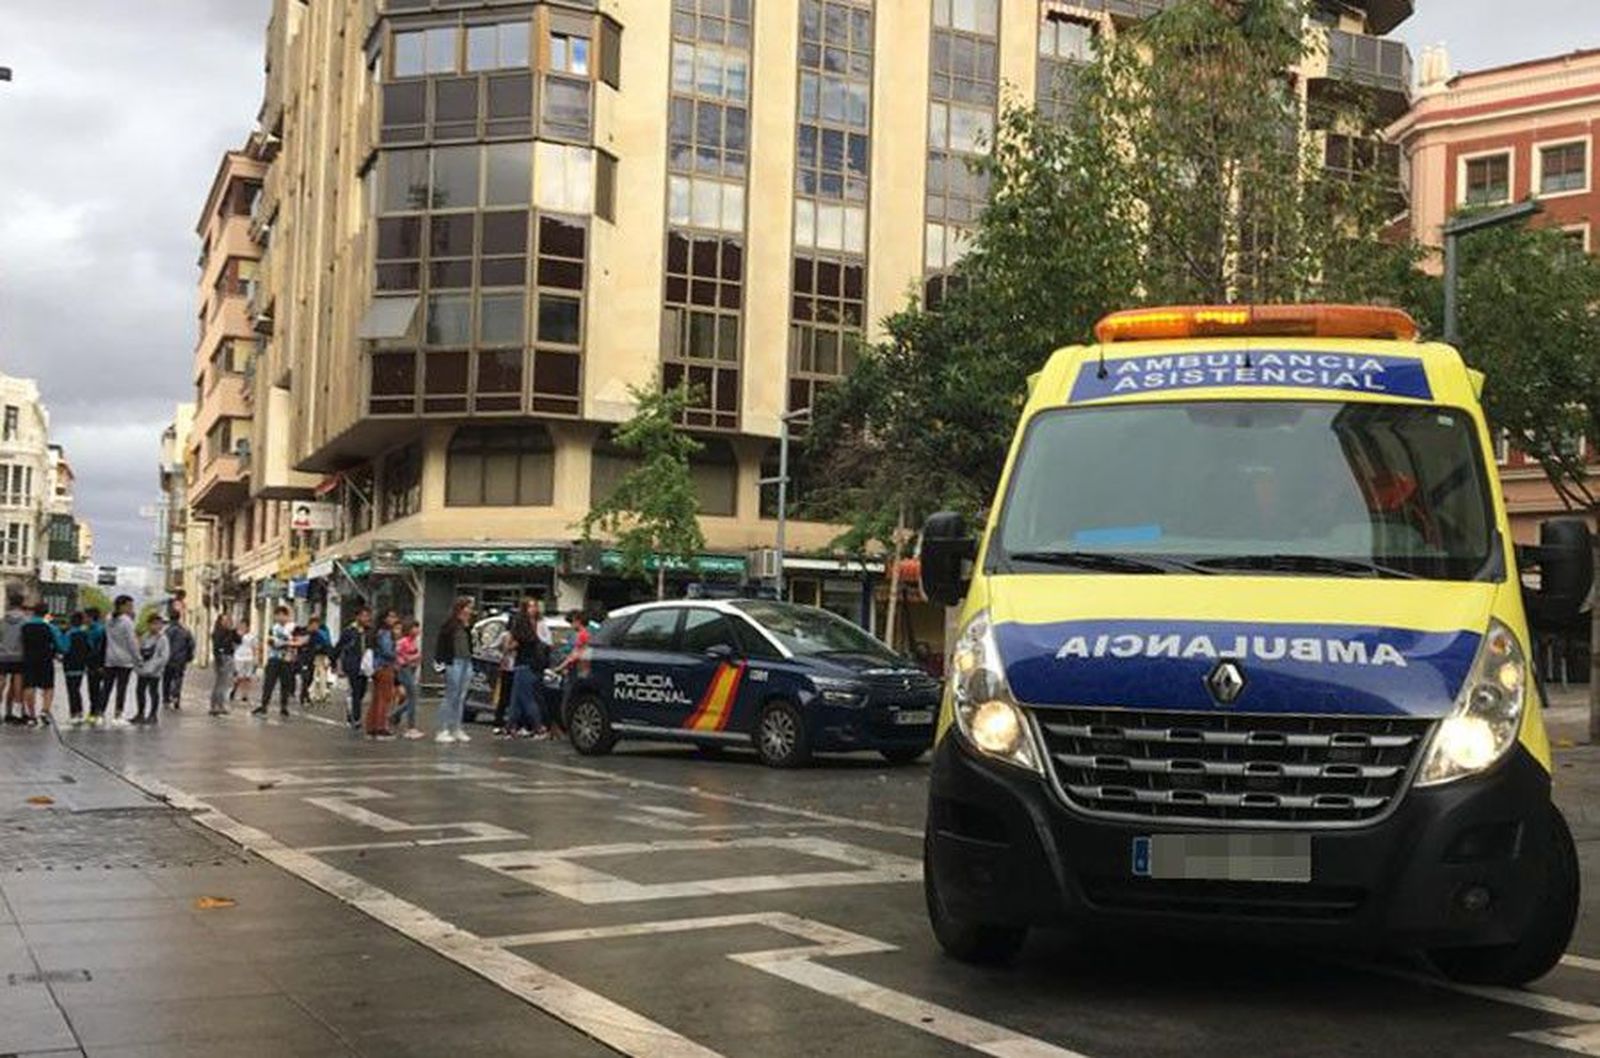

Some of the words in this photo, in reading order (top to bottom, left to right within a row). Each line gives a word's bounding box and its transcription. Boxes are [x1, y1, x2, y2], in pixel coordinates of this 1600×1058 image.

[1116, 353, 1385, 373] AMBULANCIA
[1112, 369, 1387, 391] ASISTENCIAL
[613, 672, 674, 688] POLICIA
[613, 687, 692, 704] NACIONAL
